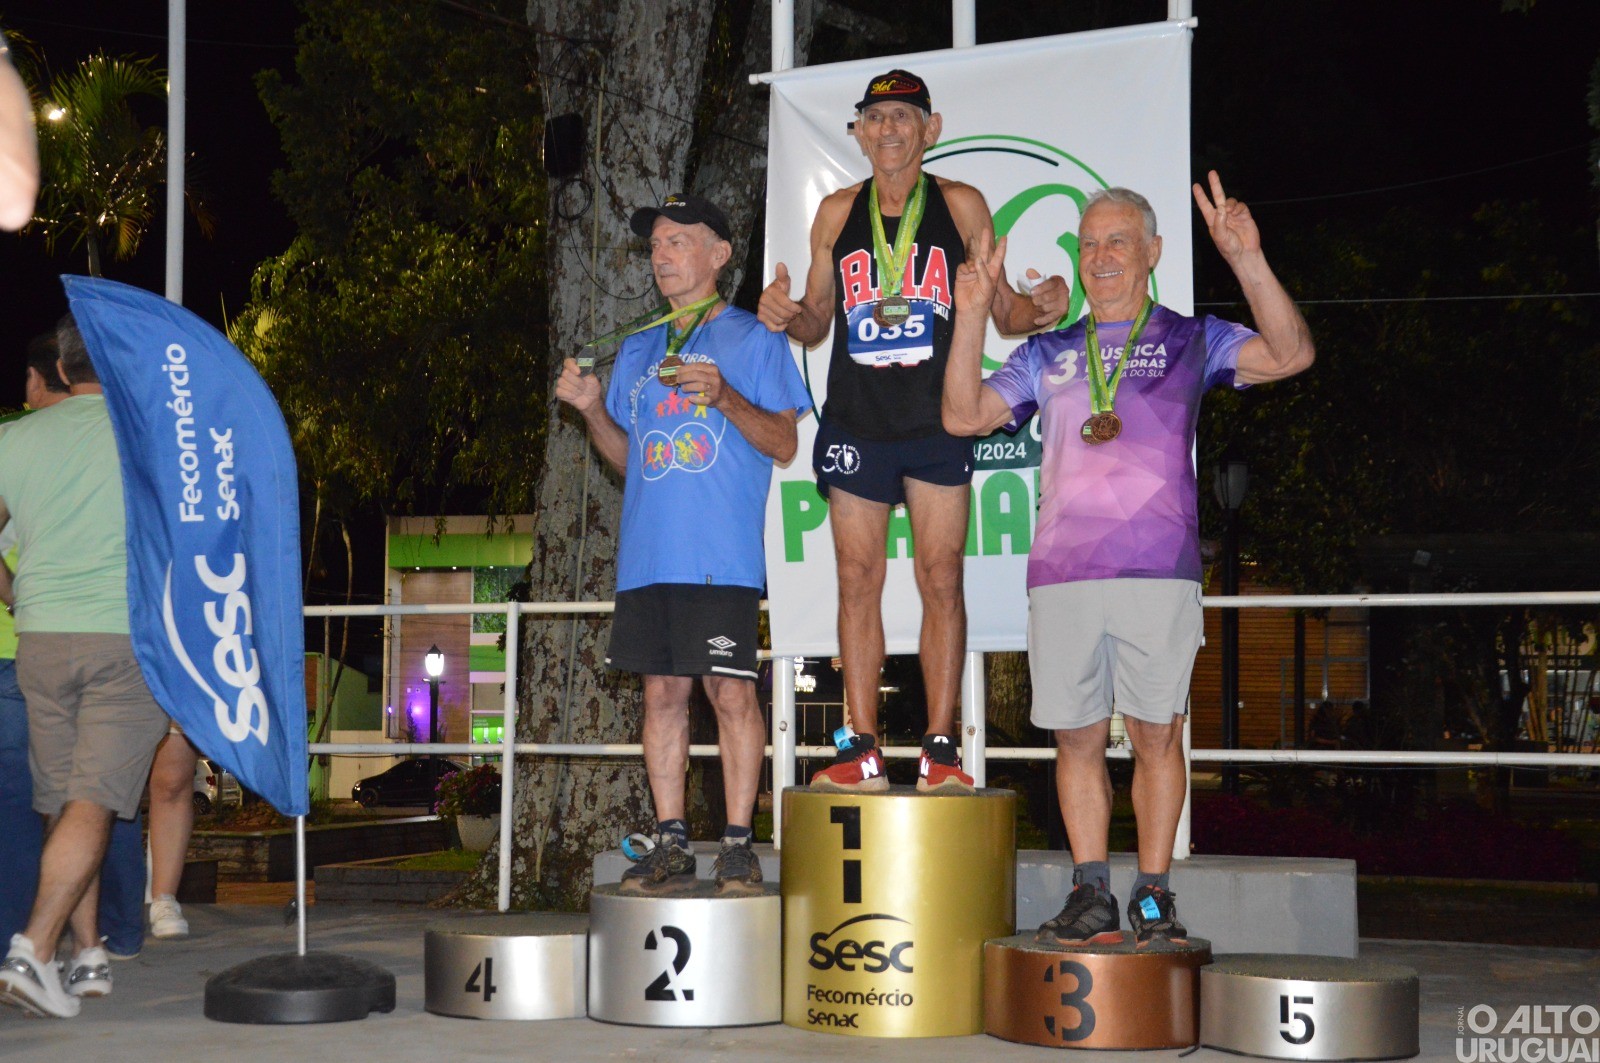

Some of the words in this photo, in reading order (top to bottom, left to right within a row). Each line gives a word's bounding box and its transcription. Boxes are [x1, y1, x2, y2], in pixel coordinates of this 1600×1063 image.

[858, 315, 925, 342] 035
[1100, 343, 1168, 361] ÚSICA
[1147, 369, 1166, 378] SUL
[162, 343, 205, 522] Fecomércio
[974, 442, 1027, 461] /2024
[209, 427, 240, 521] Senac
[195, 552, 270, 747] Sesc
[709, 649, 733, 658] umbro
[830, 806, 862, 904] 1
[644, 925, 694, 1001] 2
[808, 932, 914, 973] Sesc
[465, 957, 497, 1002] 4
[807, 984, 914, 1007] Fecomércio
[1044, 960, 1096, 1041] 3
[807, 1008, 859, 1028] Senac
[1279, 994, 1315, 1045] 5
